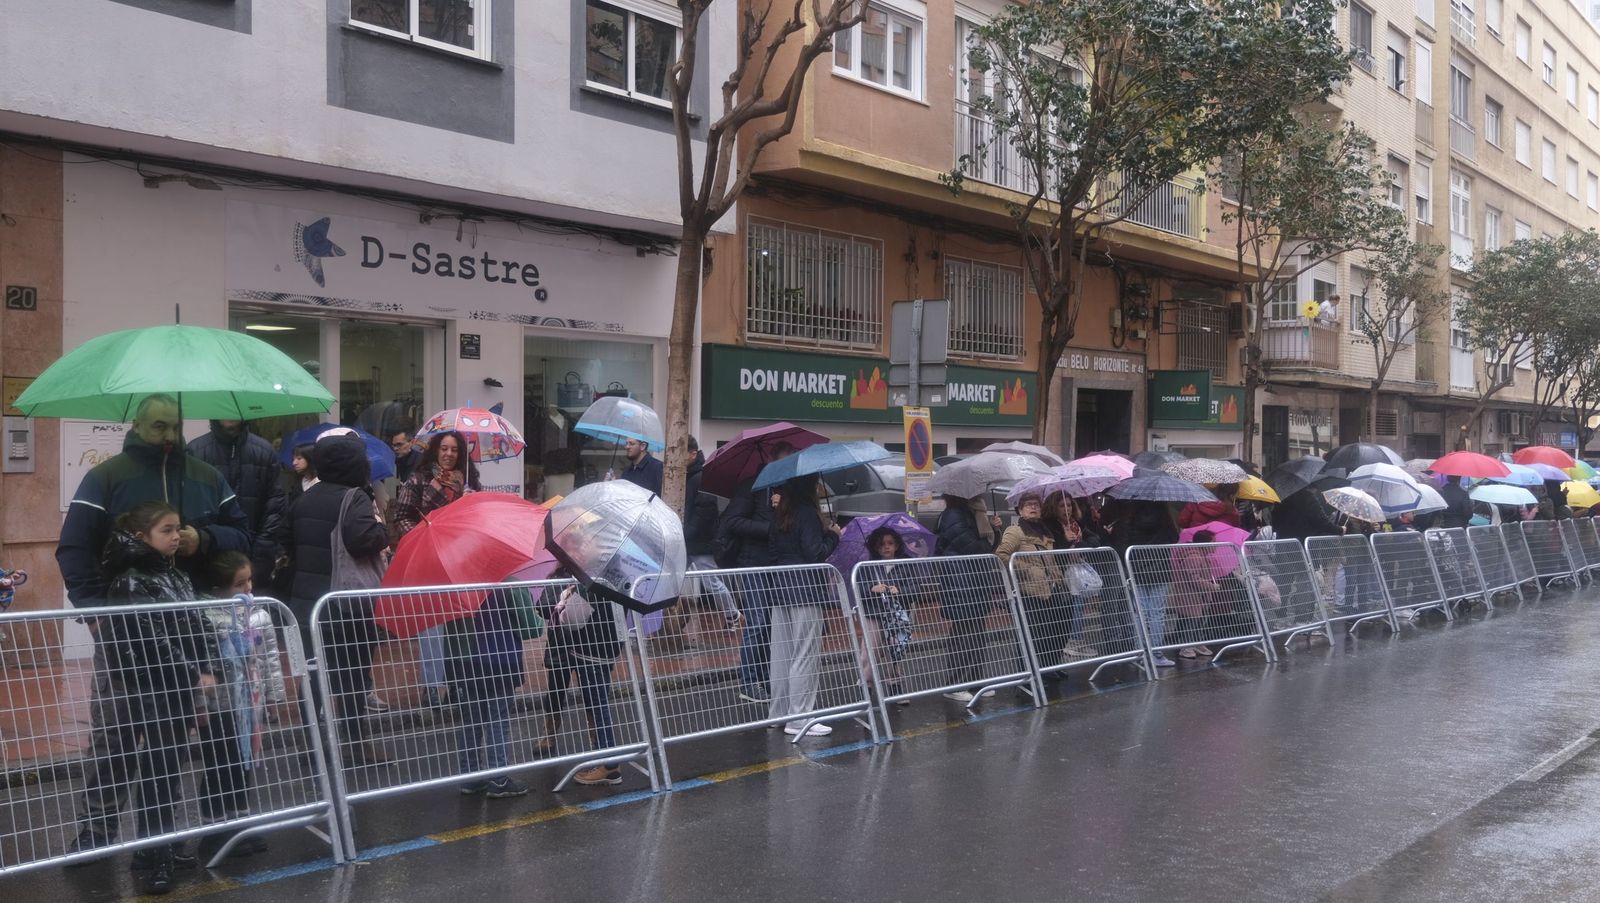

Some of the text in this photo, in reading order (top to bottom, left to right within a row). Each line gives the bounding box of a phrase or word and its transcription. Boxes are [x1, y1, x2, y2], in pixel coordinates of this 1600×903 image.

[361, 236, 540, 287] D-Sastre
[8, 287, 35, 308] 20
[1070, 354, 1089, 370] BELO
[1093, 356, 1129, 373] HORIZONTE
[740, 368, 847, 395] DON MARKET
[948, 382, 997, 402] MARKET
[811, 399, 844, 409] descuento
